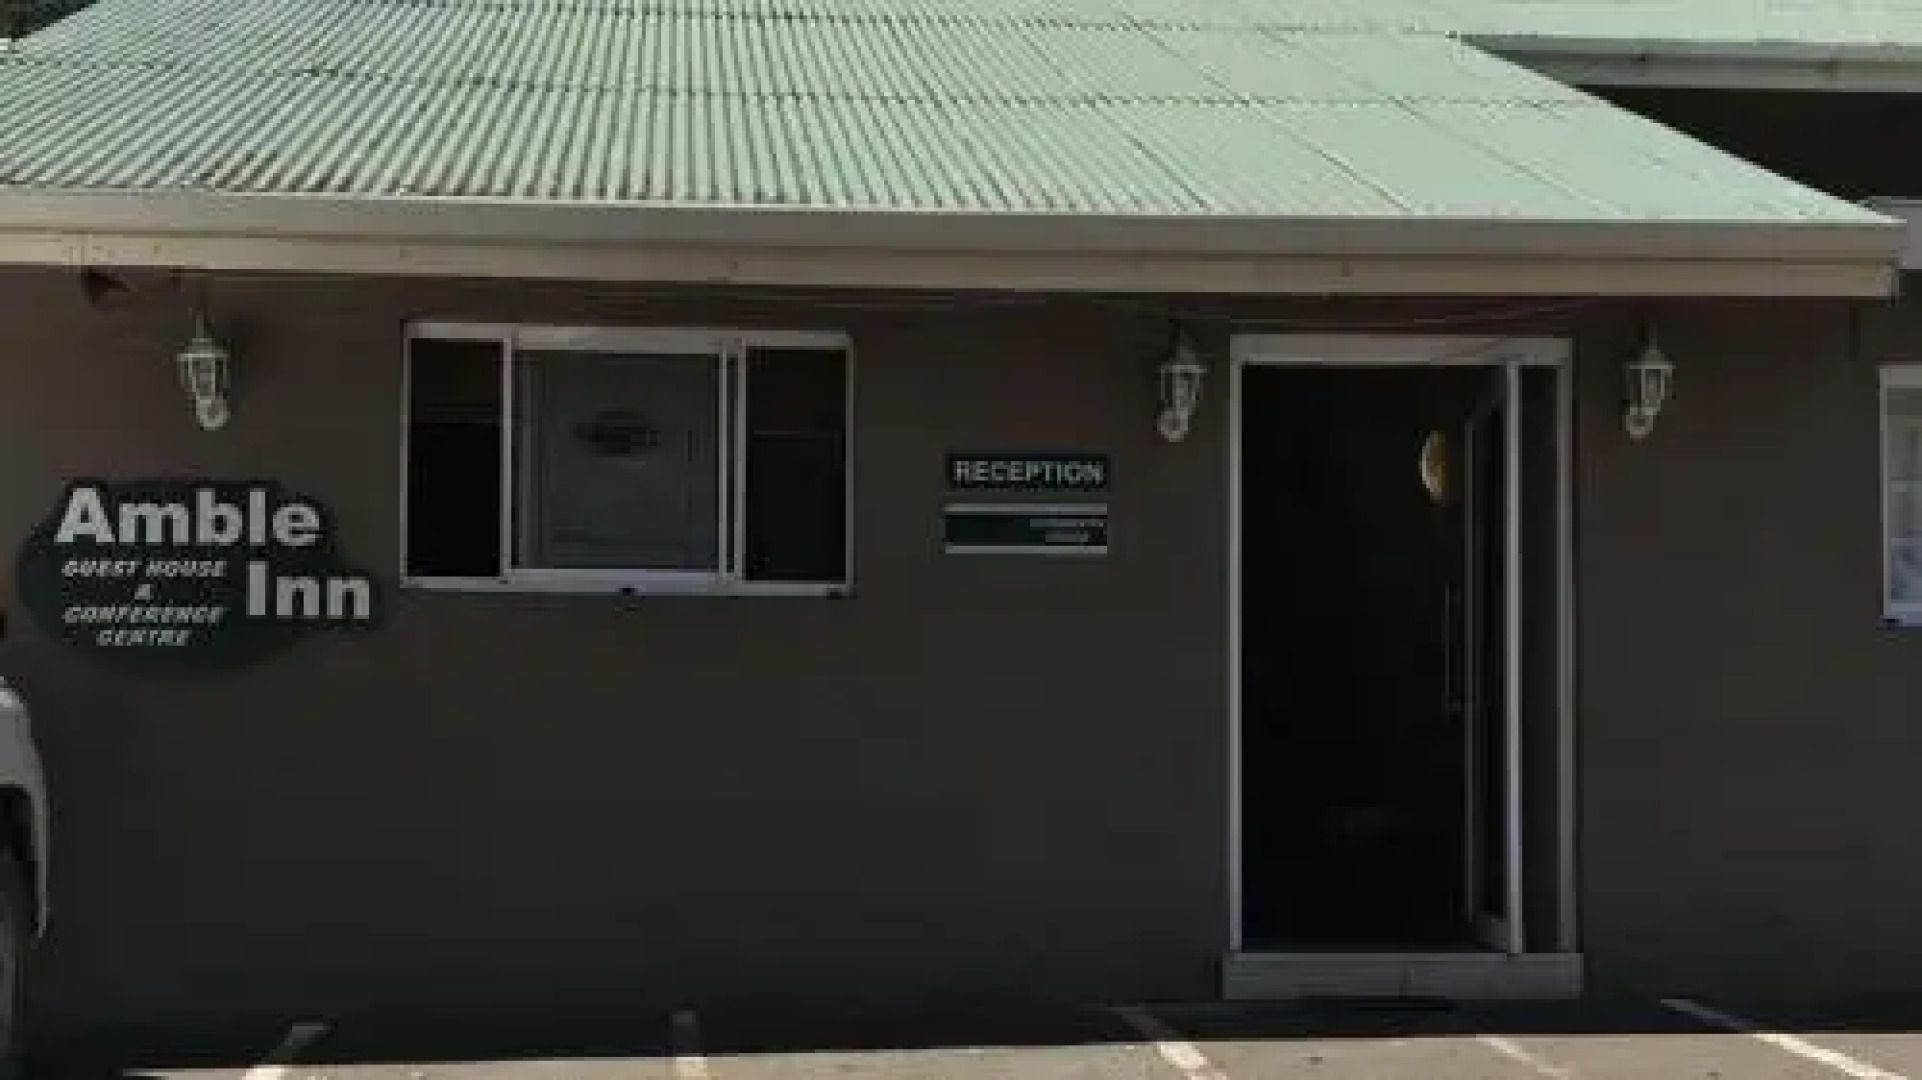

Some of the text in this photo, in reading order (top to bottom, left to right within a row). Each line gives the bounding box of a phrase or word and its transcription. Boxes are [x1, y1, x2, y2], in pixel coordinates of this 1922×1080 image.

[953, 460, 1104, 484] RECEPTION
[54, 487, 321, 546] Amble
[61, 560, 228, 577] GUEST HOUSE
[246, 560, 370, 619] Inn
[62, 606, 226, 623] CONFERENCE
[96, 629, 192, 646] CENTRE
